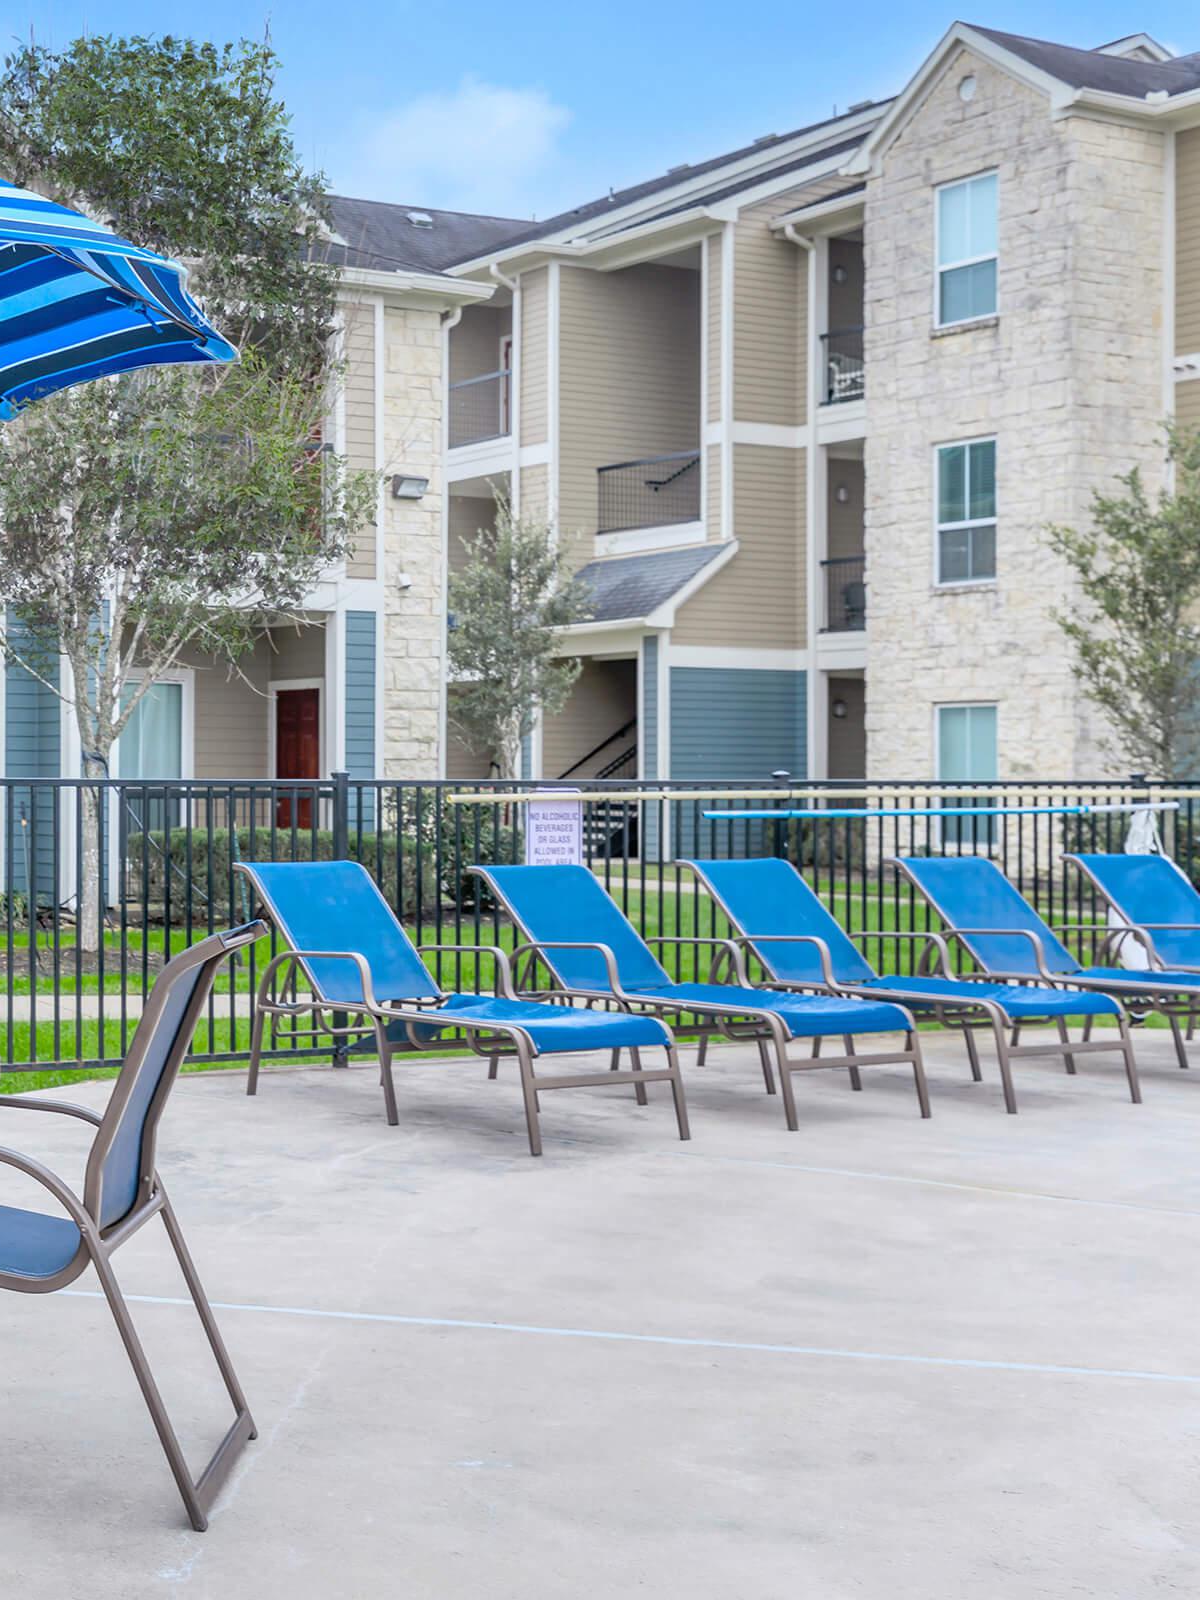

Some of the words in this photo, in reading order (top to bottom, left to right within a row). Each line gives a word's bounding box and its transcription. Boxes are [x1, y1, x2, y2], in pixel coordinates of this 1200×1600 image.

[530, 812, 540, 820] NO
[542, 812, 578, 820] ALCOHOLIC
[535, 824, 573, 832] BEVERAGES
[537, 835, 547, 843] OR
[549, 835, 571, 843] GLASS
[534, 847, 566, 855] ALLOWED
[568, 847, 575, 855] IN
